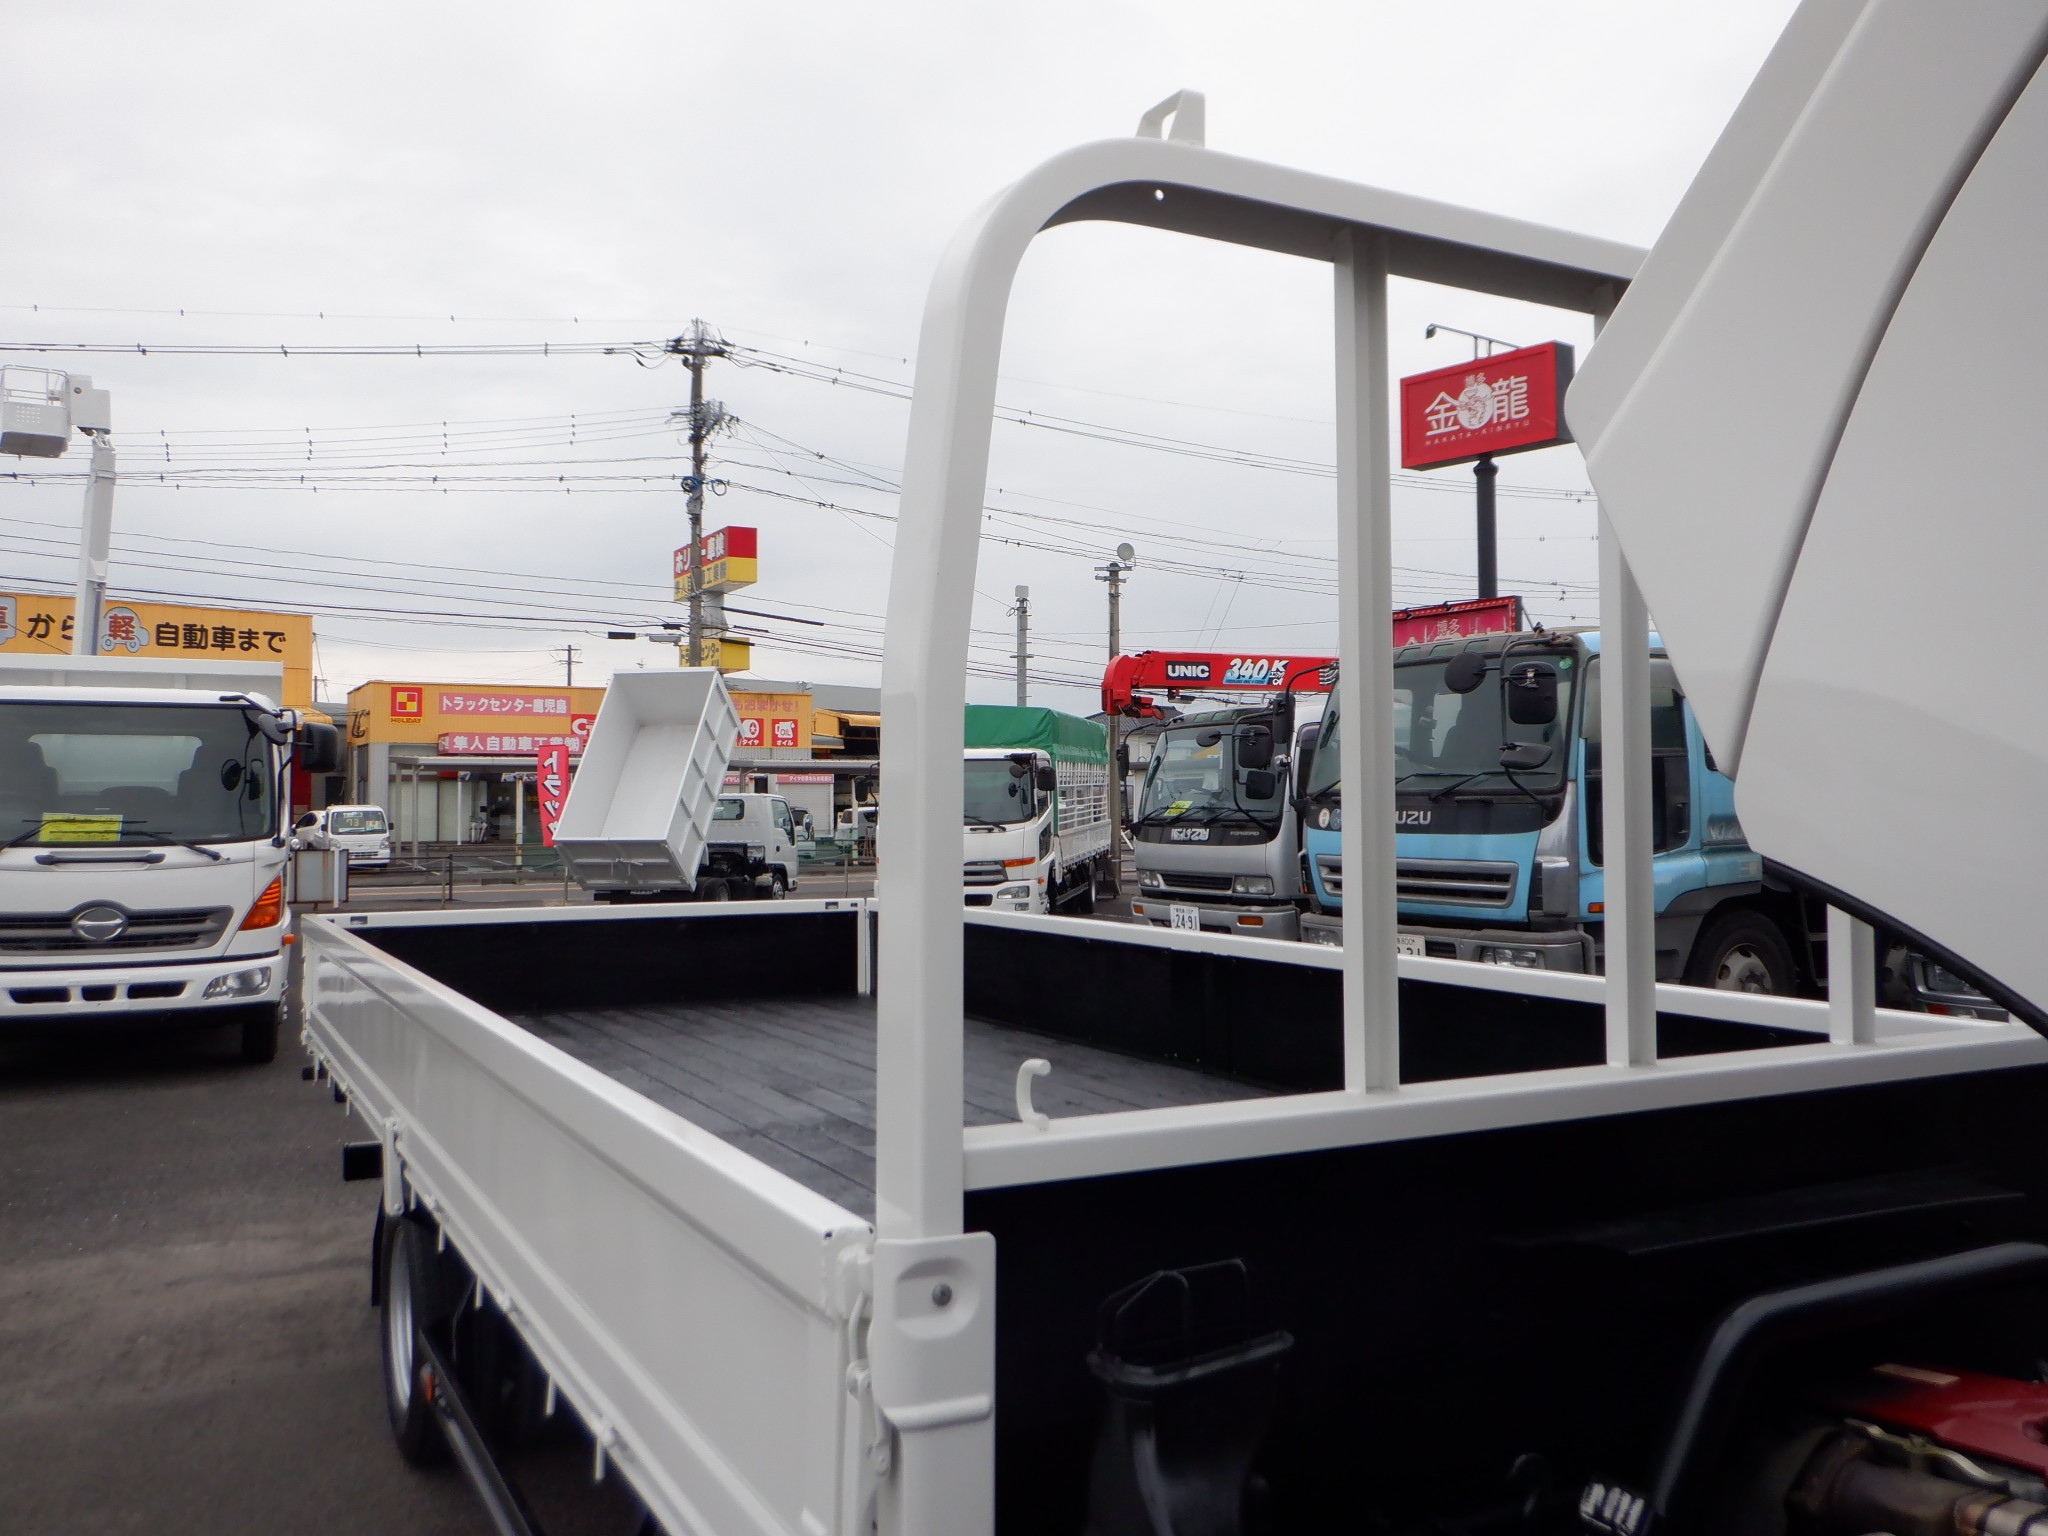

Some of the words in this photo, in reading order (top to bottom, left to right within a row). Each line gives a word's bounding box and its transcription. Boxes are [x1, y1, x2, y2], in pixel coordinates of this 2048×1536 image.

[107, 613, 136, 641] 軽
[155, 622, 287, 654] 自動車まで
[1167, 664, 1210, 678] UNIC
[1229, 657, 1269, 680] 340
[442, 696, 567, 714] トラックセンター鹿児島
[1395, 810, 1432, 825] UZU
